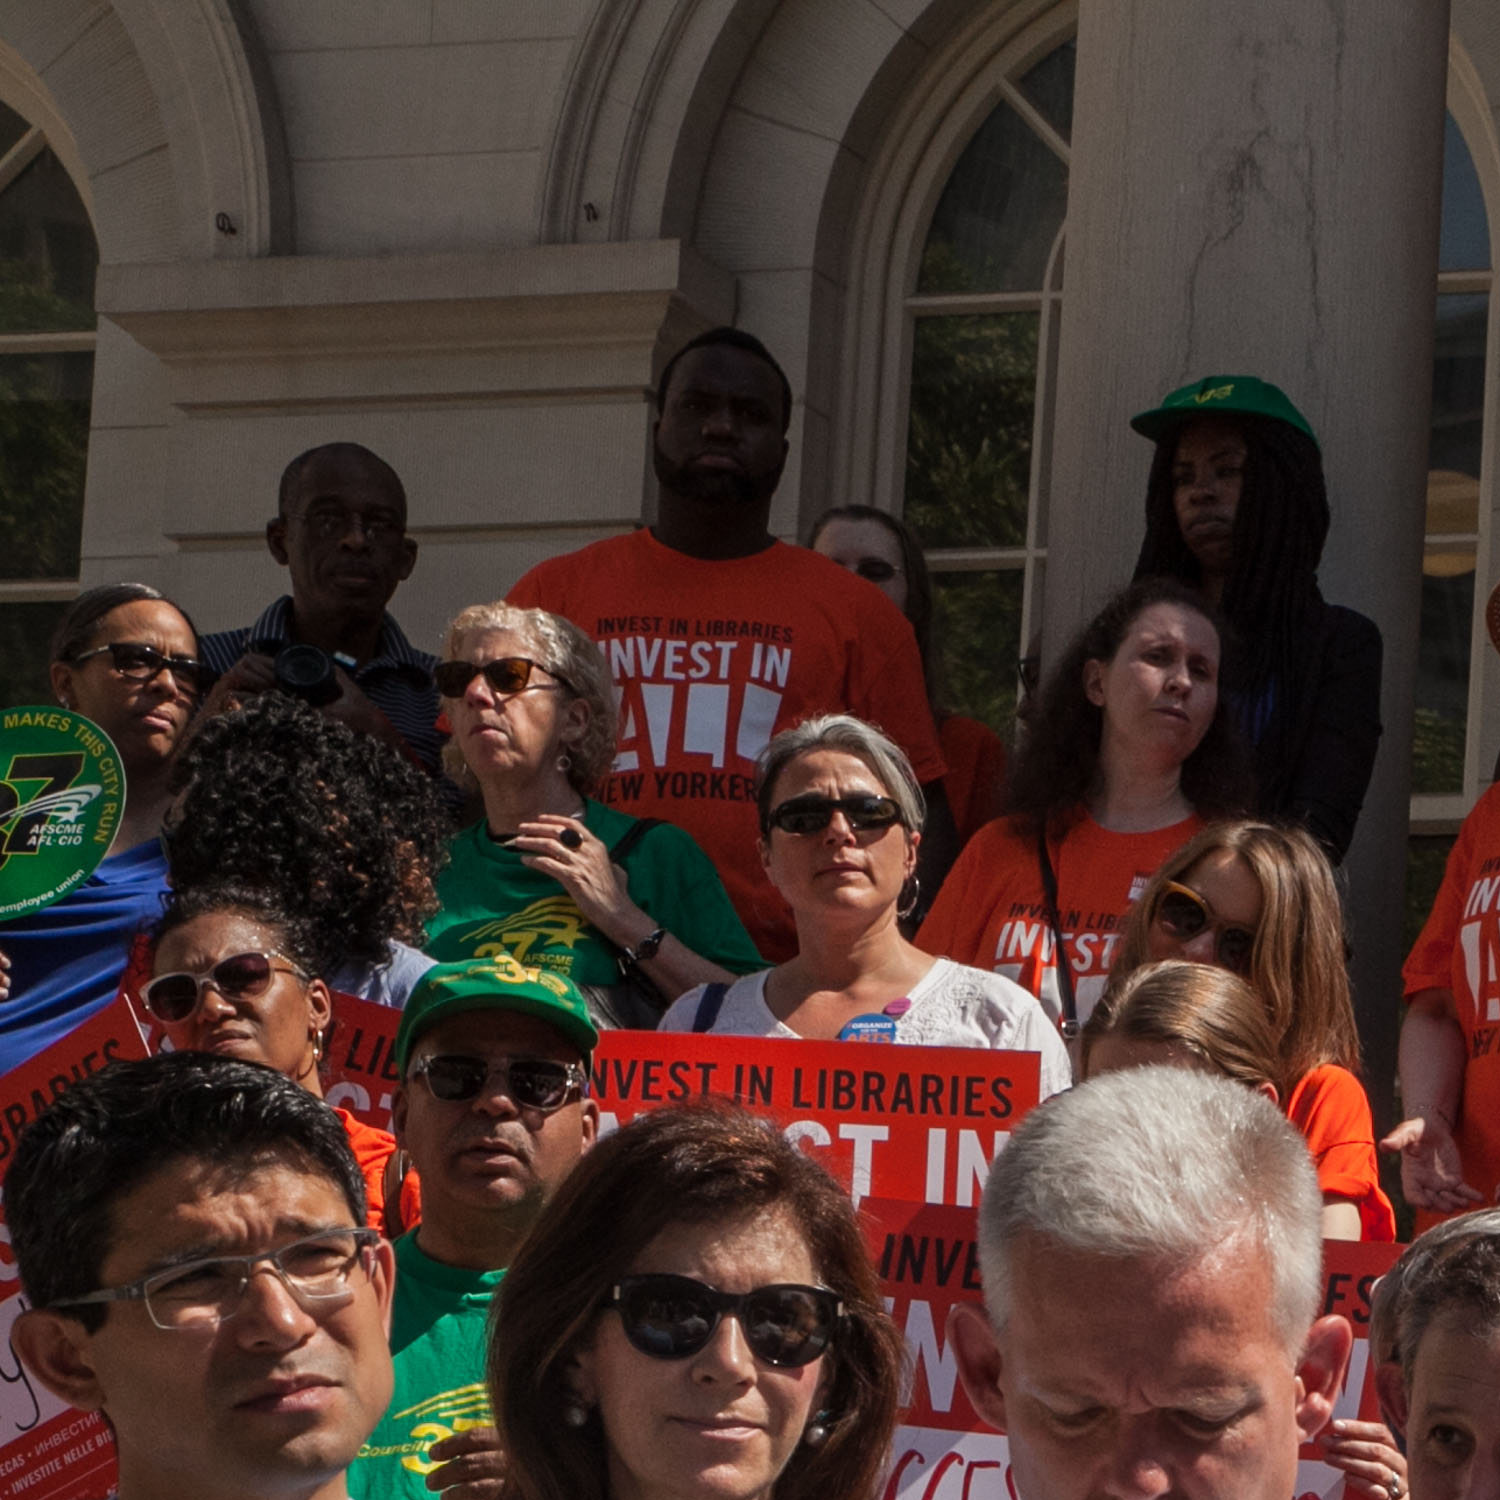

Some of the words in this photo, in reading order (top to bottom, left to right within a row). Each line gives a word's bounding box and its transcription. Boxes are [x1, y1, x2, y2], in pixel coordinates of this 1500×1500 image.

[597, 617, 663, 634] INVEST
[669, 619, 688, 635] IN
[694, 620, 793, 643] LIBRARIES
[750, 643, 791, 688] IN
[4, 712, 72, 732] MAKES
[73, 724, 106, 757] THIS
[98, 756, 119, 795] CITY
[602, 772, 644, 801] EW
[30, 823, 85, 834] AFSCME
[93, 802, 118, 843] RUN
[56, 868, 85, 893] union
[523, 953, 575, 966] AFSCME
[734, 1064, 773, 1106] IN
[793, 1067, 1013, 1119] LIBRARIES
[357, 1440, 425, 1458] Council
[11, 1462, 62, 1495] INVESTITE
[64, 1441, 94, 1465] NELLE
